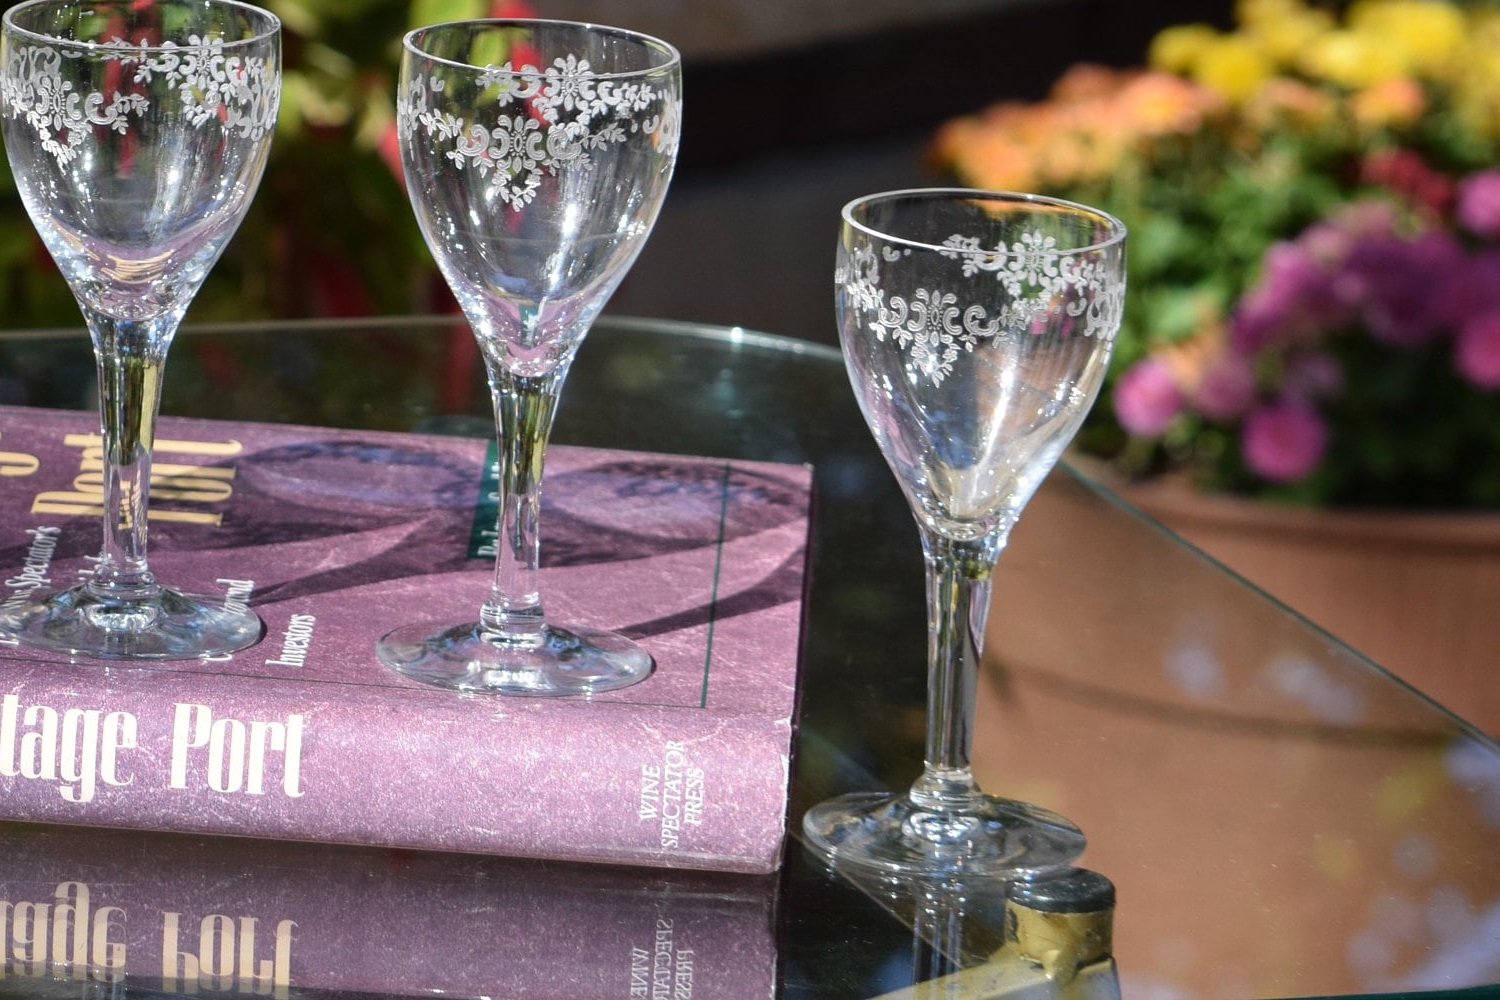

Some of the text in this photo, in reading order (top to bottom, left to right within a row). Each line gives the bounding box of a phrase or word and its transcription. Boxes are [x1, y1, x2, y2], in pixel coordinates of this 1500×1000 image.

[4, 526, 62, 588] Spectator's
[264, 613, 316, 667] Investors
[168, 702, 308, 798] Port
[639, 764, 661, 820] WINE
[661, 740, 684, 849] SPECTATOR
[684, 767, 705, 826] PRESS
